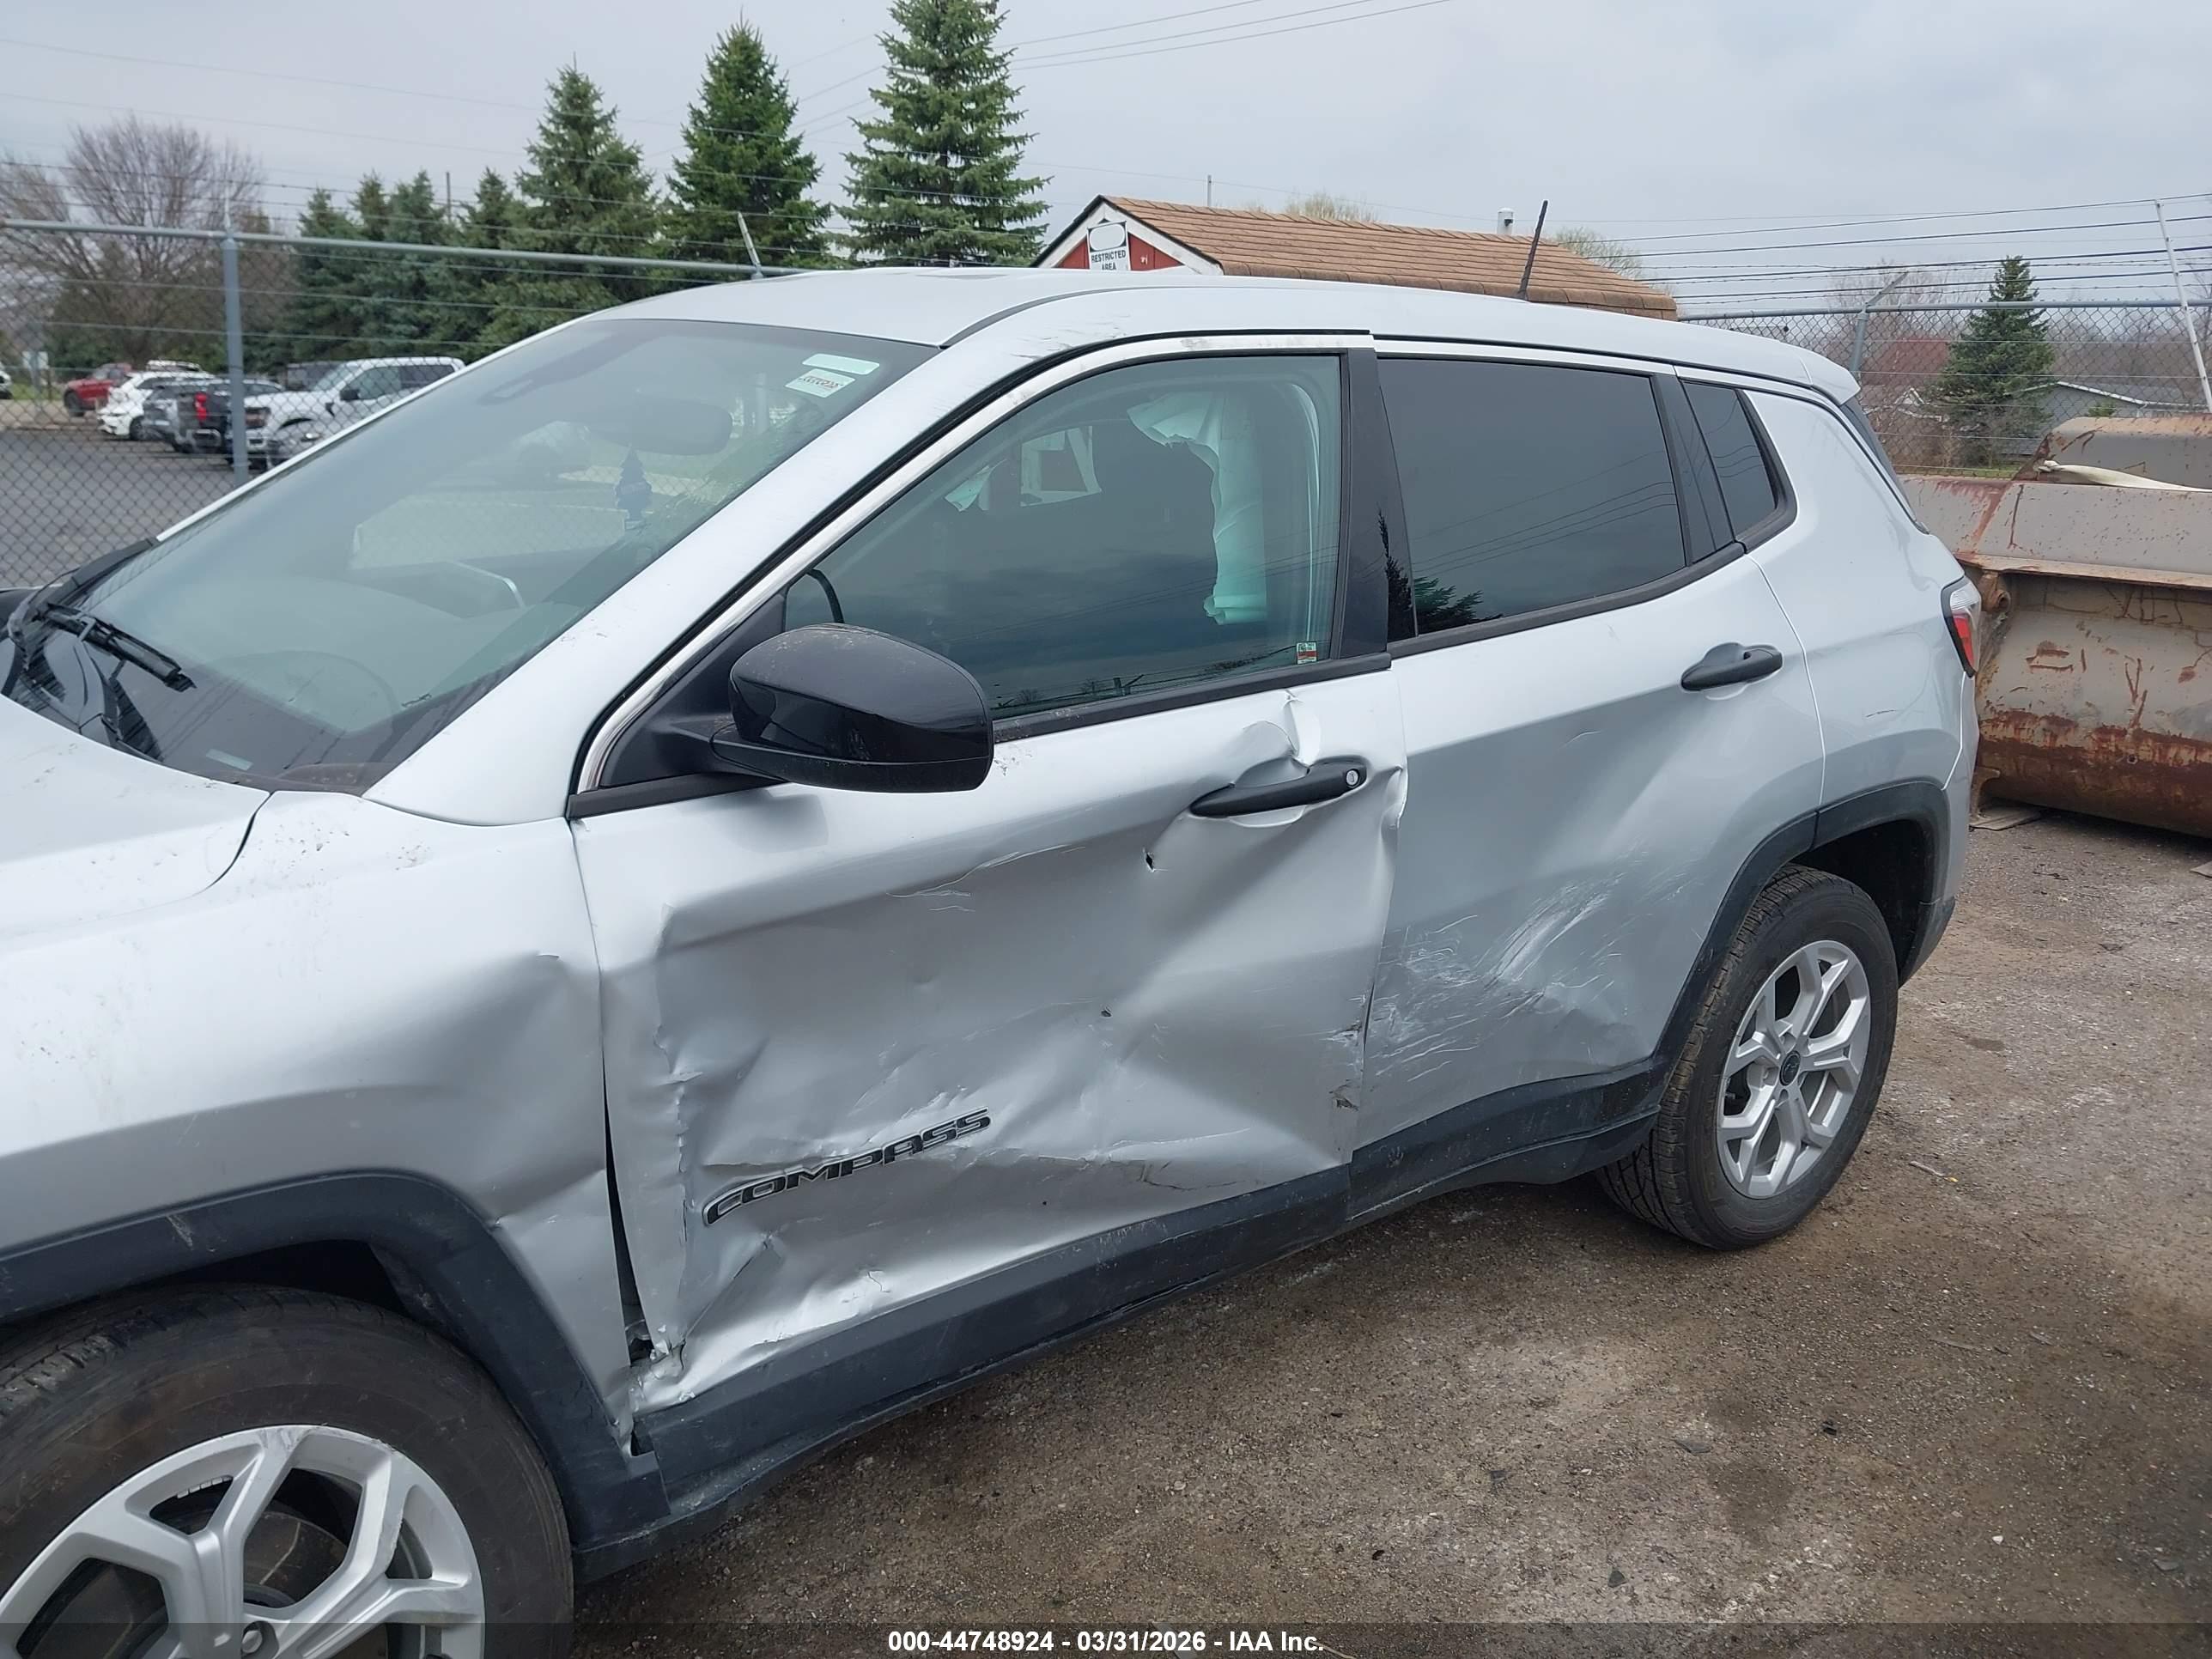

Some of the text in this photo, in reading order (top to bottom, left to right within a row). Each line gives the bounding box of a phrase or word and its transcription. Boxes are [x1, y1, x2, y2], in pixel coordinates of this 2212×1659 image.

[1091, 250, 1126, 262] RESTRICTED
[1102, 262, 1116, 270] AREA
[702, 1106, 992, 1226] COMPASS
